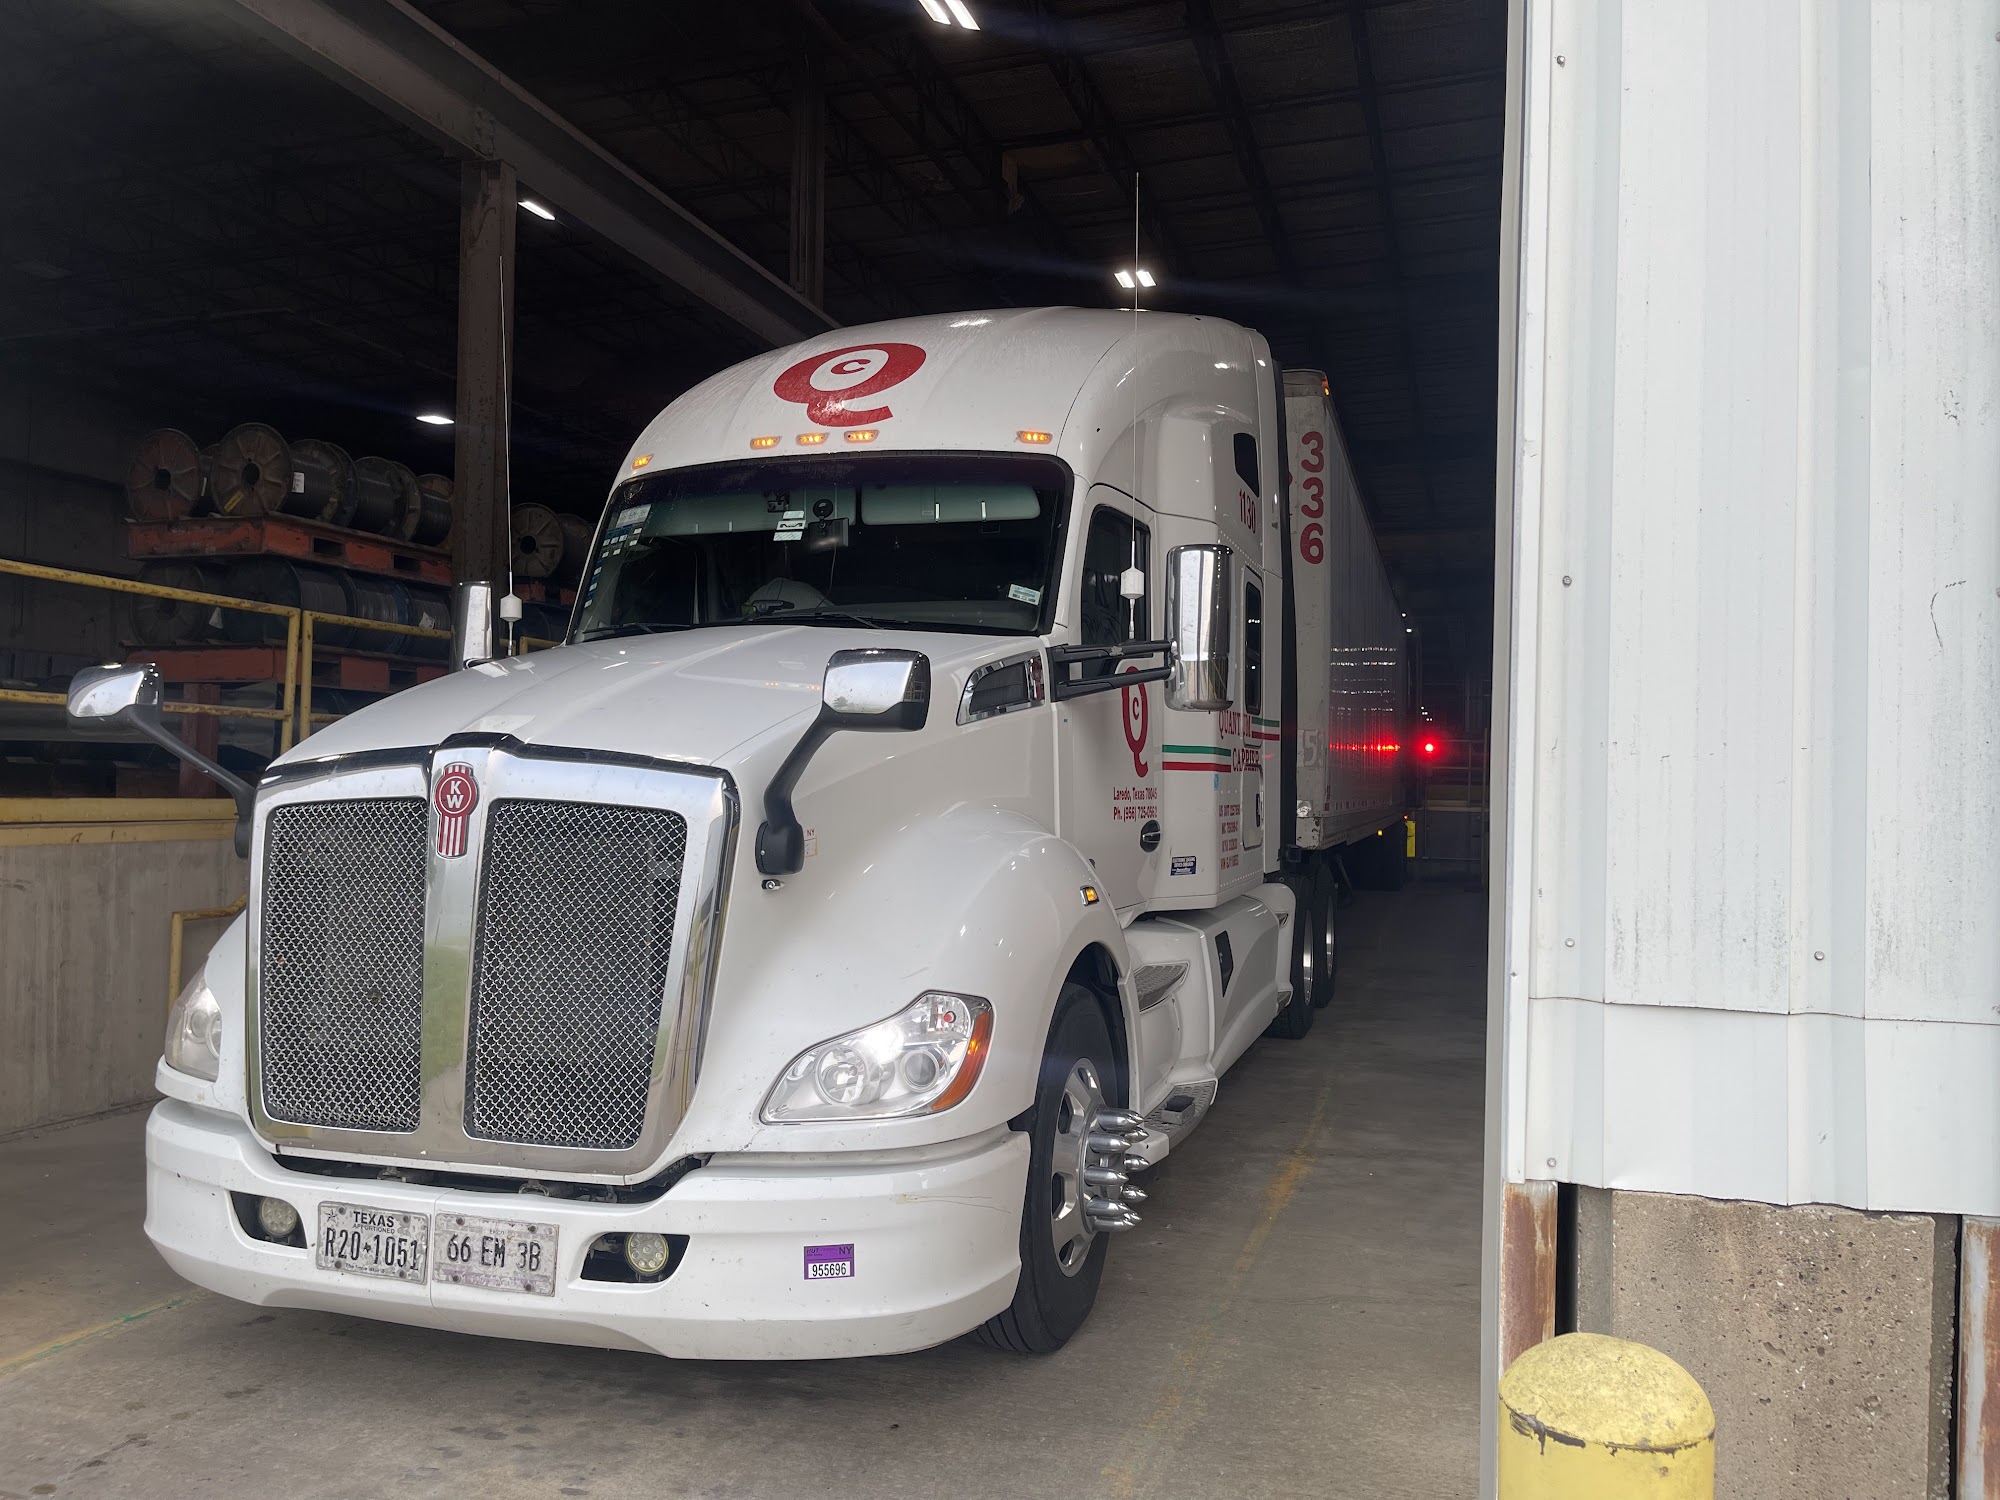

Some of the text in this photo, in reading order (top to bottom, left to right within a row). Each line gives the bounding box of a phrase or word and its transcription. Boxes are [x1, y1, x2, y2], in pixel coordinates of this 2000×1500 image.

[1300, 431, 1325, 565] 336
[1239, 488, 1256, 534] 1130
[1113, 786, 1132, 803] Laredo,
[1132, 786, 1145, 801] Texas
[1113, 806, 1123, 821] Ph.
[353, 1210, 395, 1228] TEXAS
[446, 1233, 472, 1264] 66
[838, 1246, 853, 1255] NY
[812, 1262, 847, 1277] 955696
